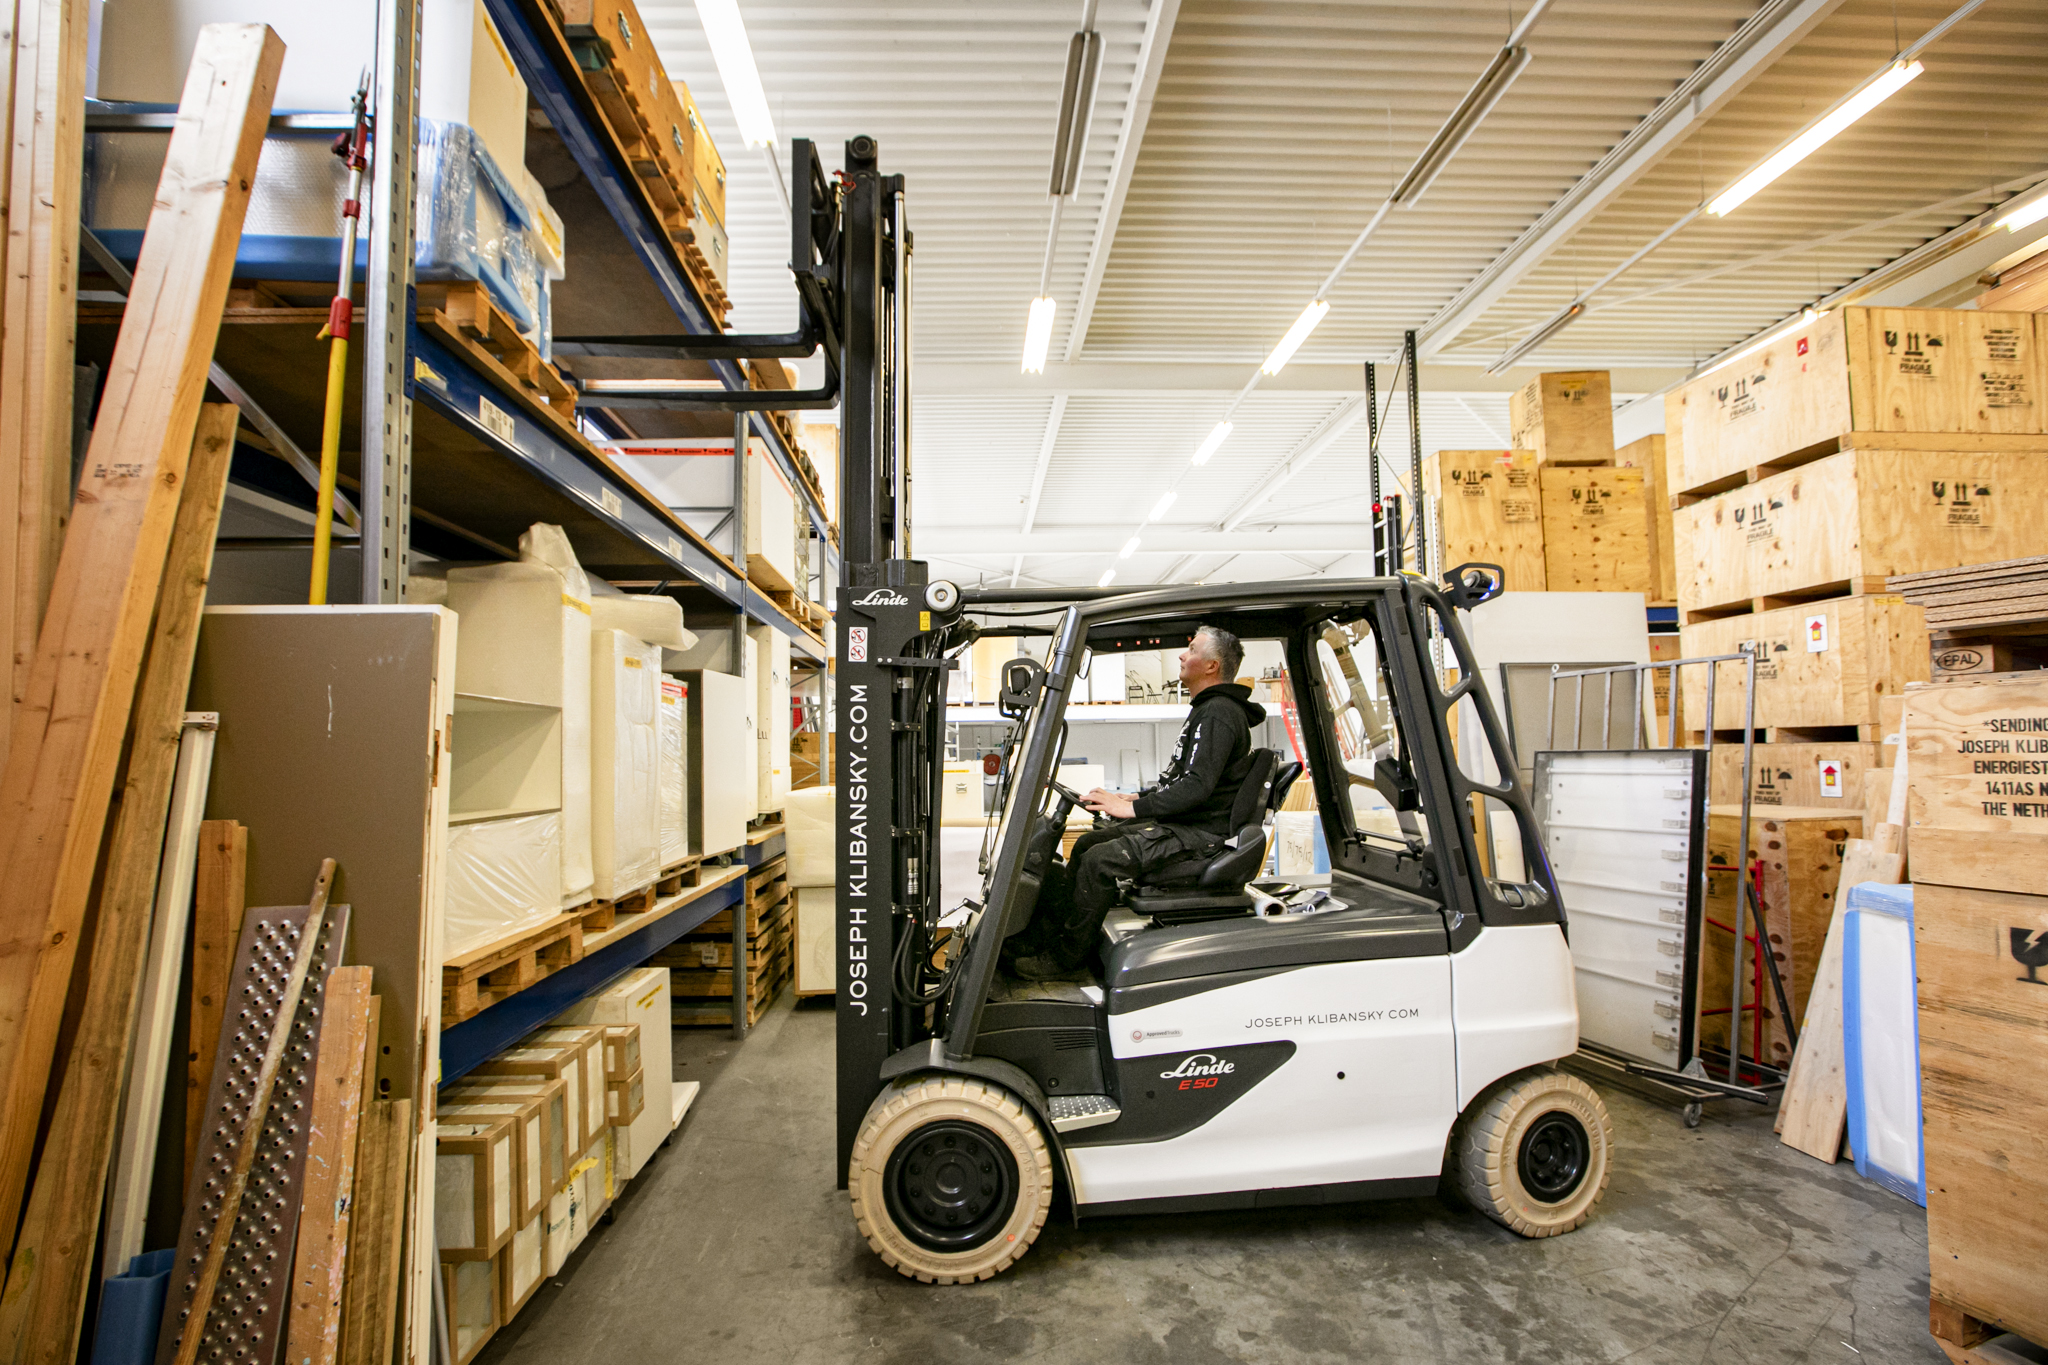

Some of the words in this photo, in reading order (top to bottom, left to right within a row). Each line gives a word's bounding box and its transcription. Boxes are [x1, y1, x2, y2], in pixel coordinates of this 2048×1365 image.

[1899, 363, 1932, 371] FRAGILE
[1947, 513, 1980, 521] FRAGILE
[852, 588, 909, 606] Linde
[1944, 653, 1976, 667] EPAL
[1957, 739, 2010, 754] JOSEPH
[2015, 739, 2048, 754] KLIB
[1973, 760, 2048, 775] ENERGIEST
[849, 684, 868, 898] KLIBANSKY.COM
[1985, 781, 2034, 796] 1411AS
[1754, 795, 1782, 803] FRAGILE
[1981, 802, 2008, 816] THE
[2012, 802, 2048, 818] NETH
[849, 908, 868, 1017] JOSEPH
[1245, 1015, 1303, 1029] JOSEPH
[1308, 1010, 1384, 1025] KLIBANSKY
[1388, 1008, 1419, 1020] COM
[1146, 1029, 1181, 1037] ApprovedTrucks
[1159, 1053, 1235, 1079] Linde
[1178, 1080, 1193, 1091] E
[1192, 1077, 1219, 1090] 50
